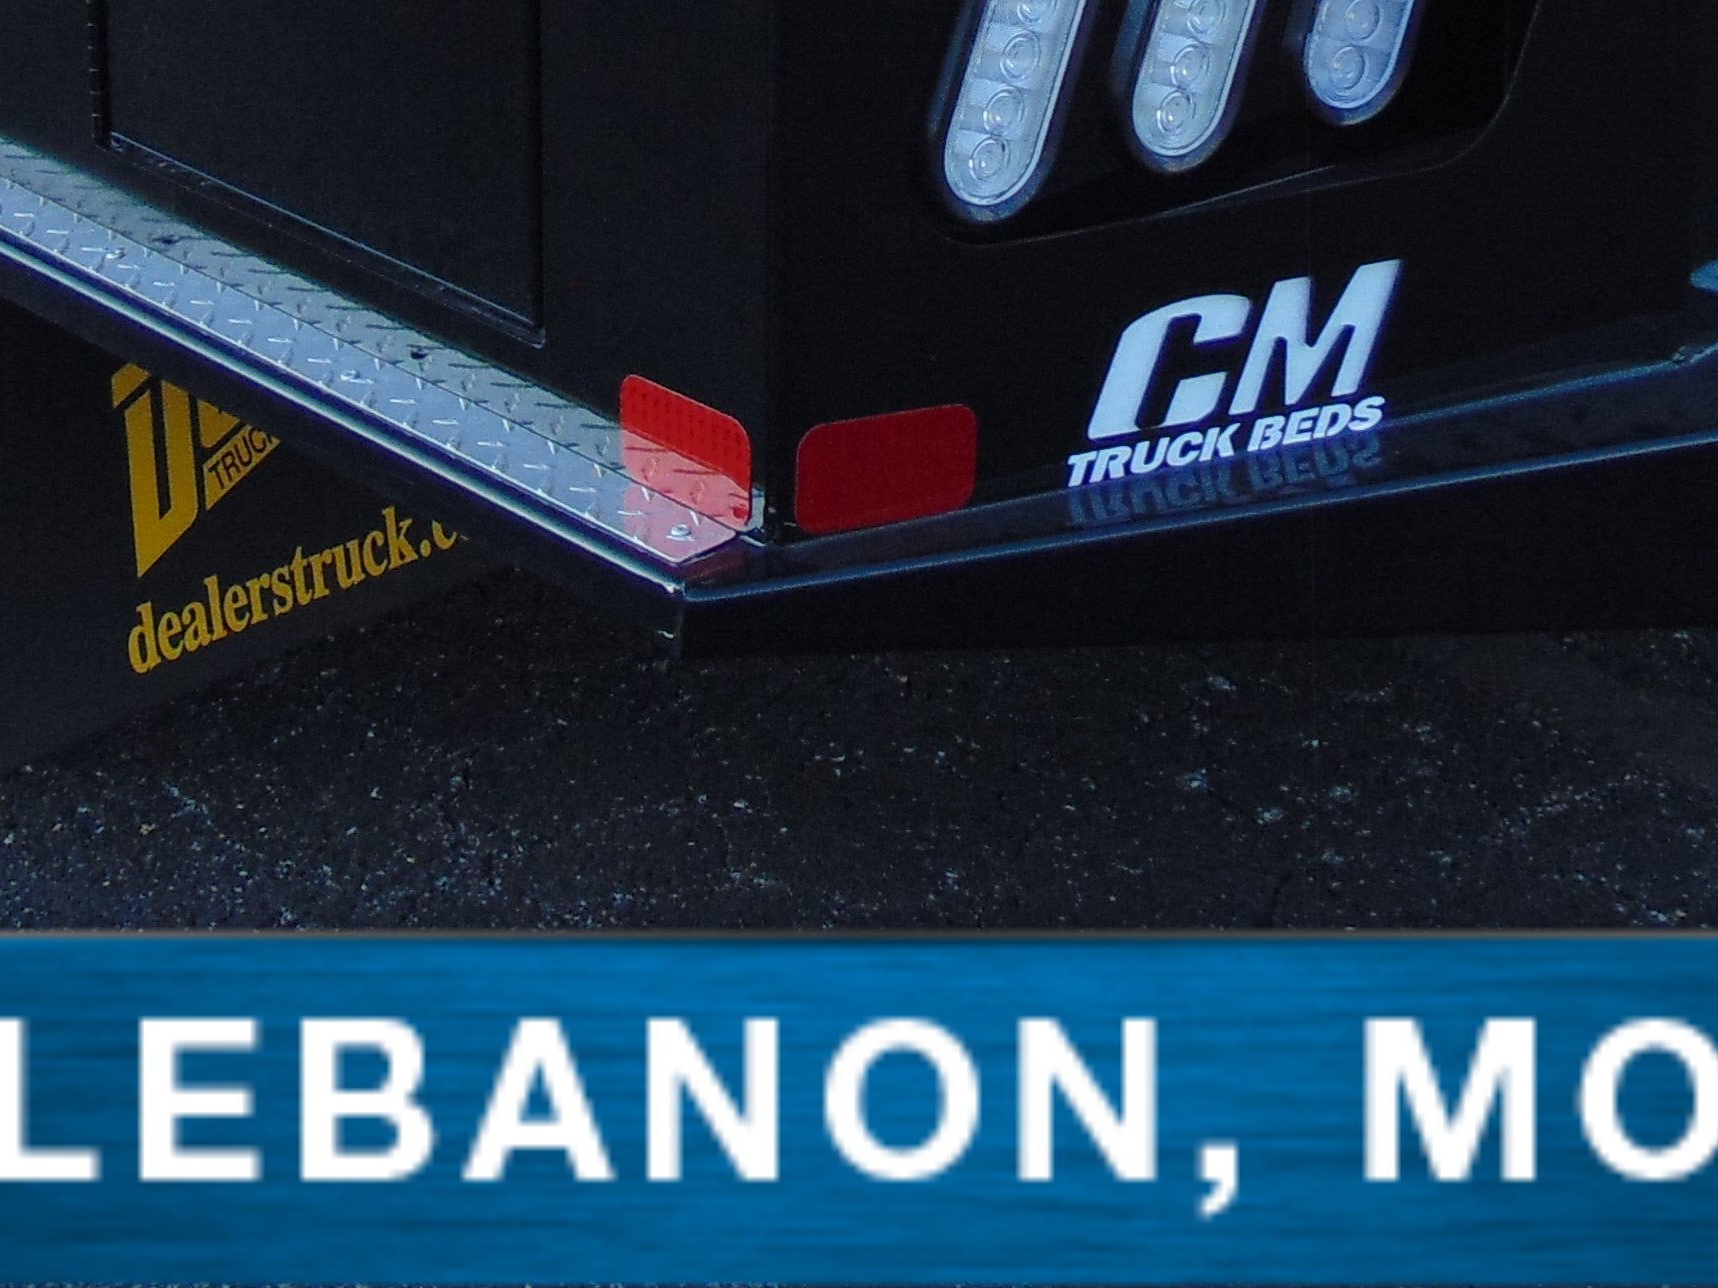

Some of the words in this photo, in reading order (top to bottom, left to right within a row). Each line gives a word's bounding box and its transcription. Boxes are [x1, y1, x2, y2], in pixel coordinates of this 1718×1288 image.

[1087, 258, 1403, 441] CM
[208, 427, 273, 491] TRUC
[1067, 422, 1234, 487] TRUCK
[1246, 395, 1386, 453] BEDS
